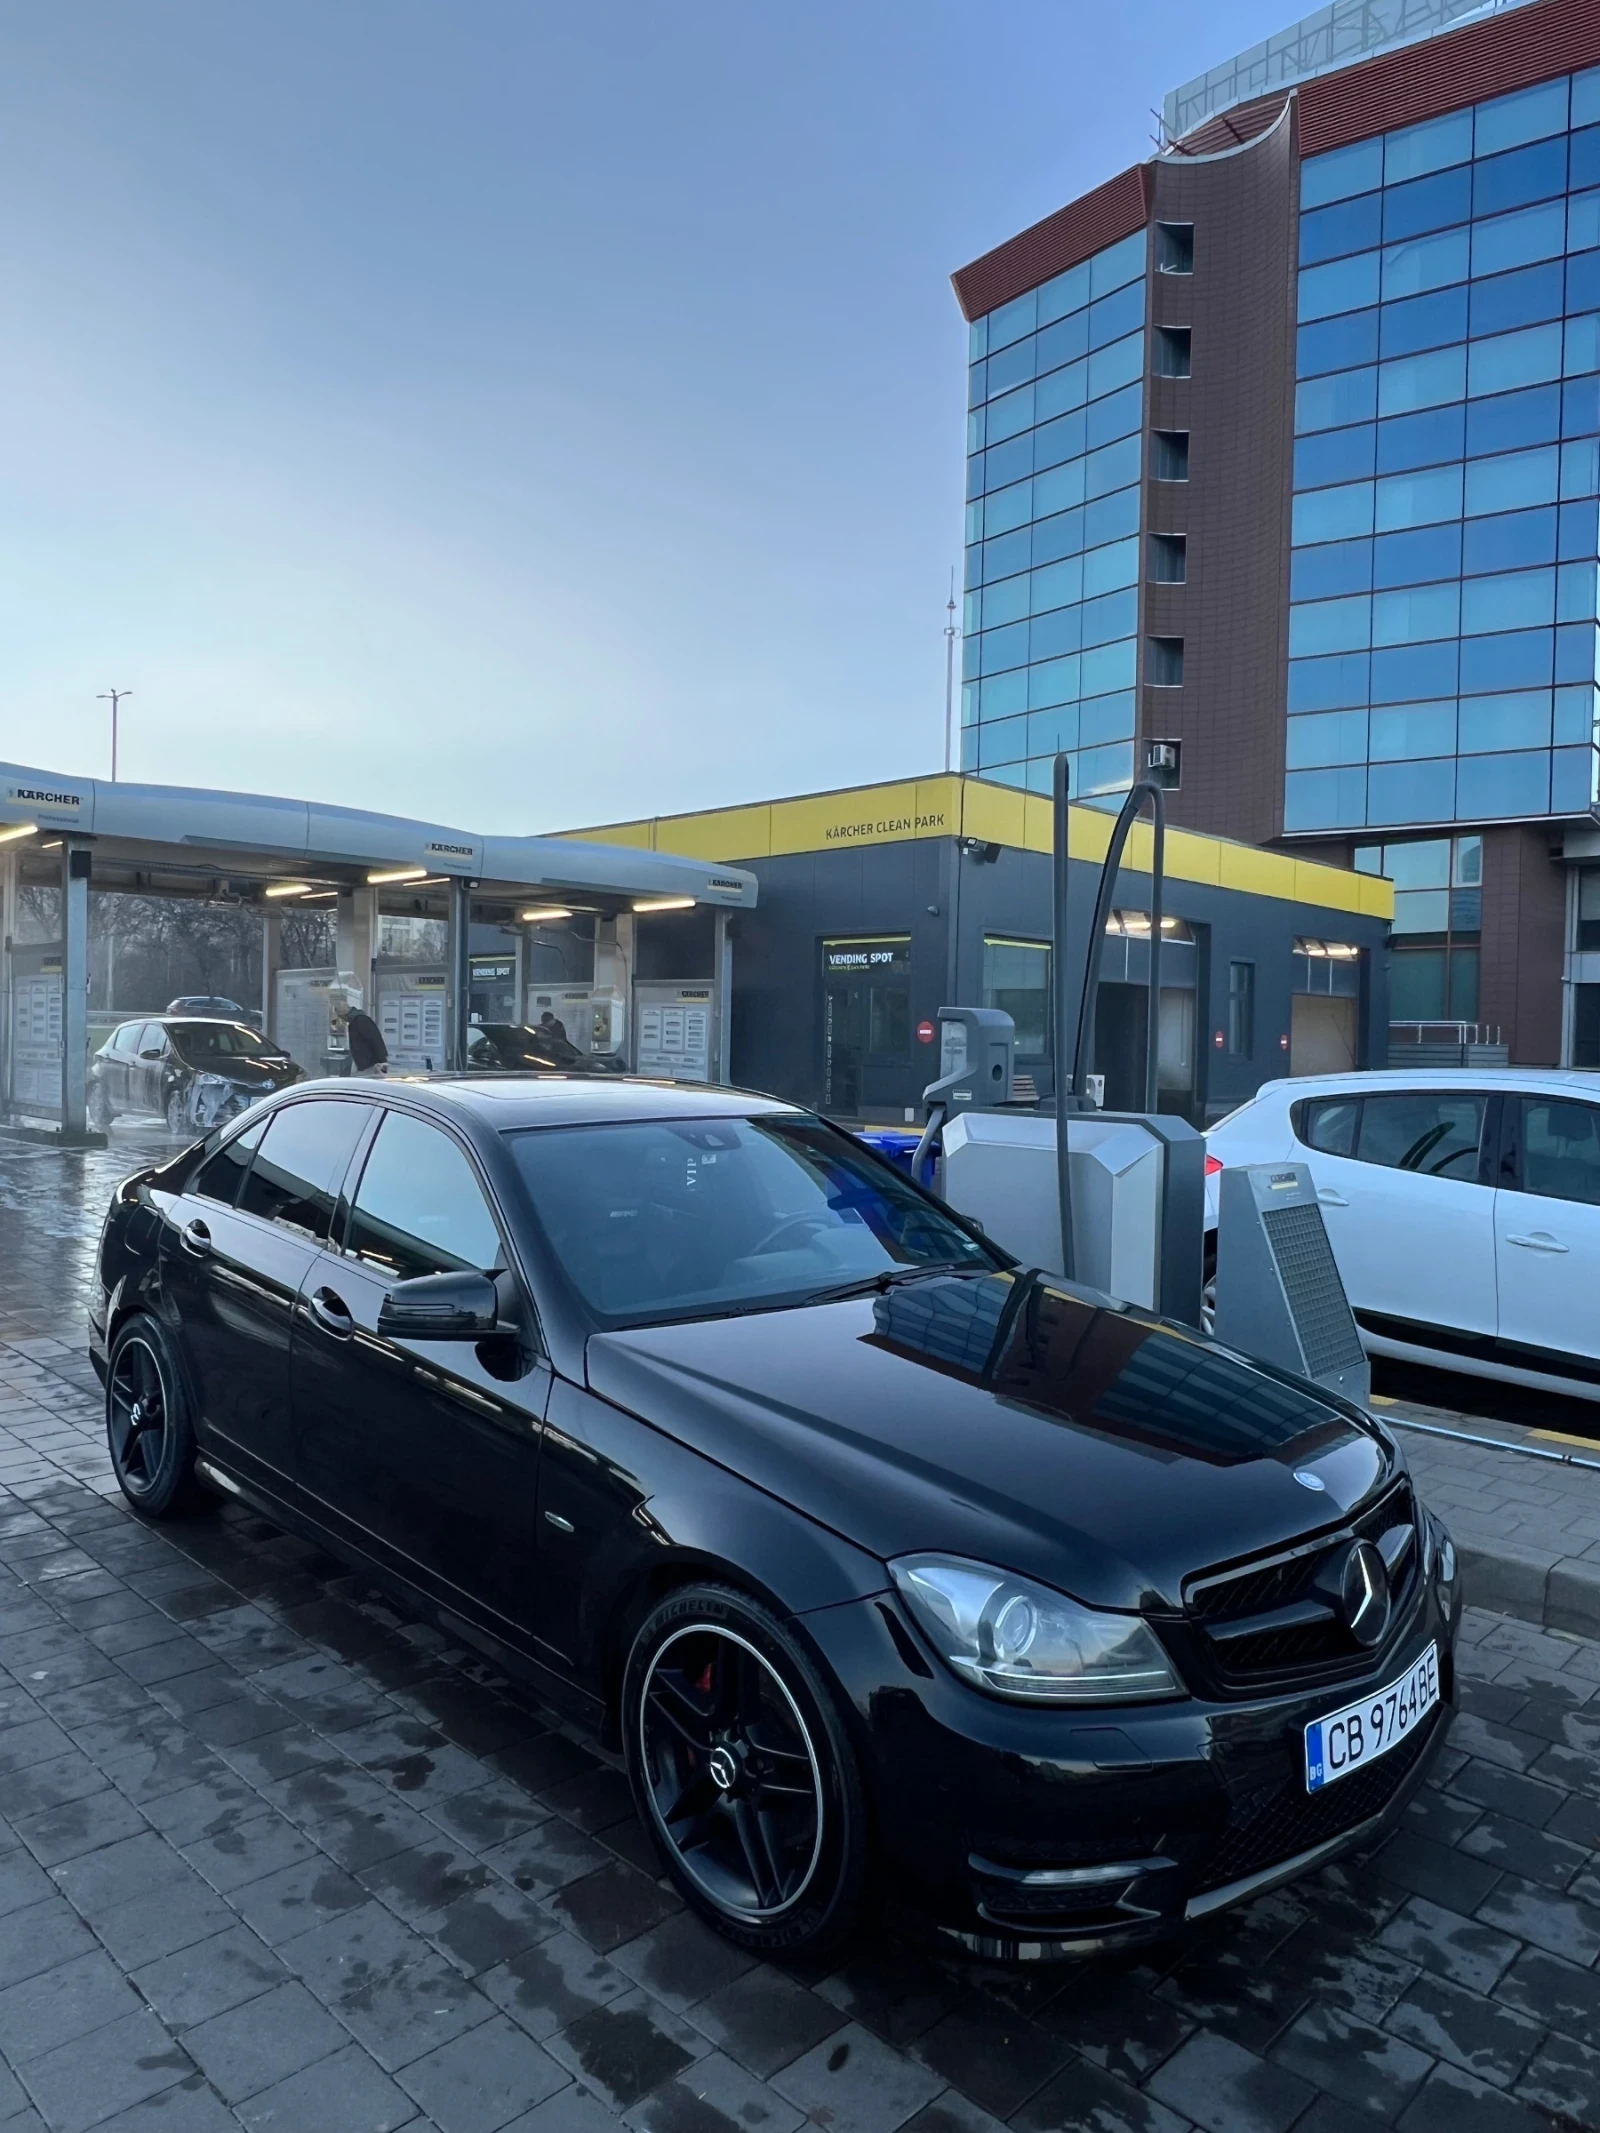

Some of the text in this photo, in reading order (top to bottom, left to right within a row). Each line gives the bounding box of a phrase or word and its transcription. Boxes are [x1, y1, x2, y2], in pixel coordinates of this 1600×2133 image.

[876, 818, 911, 834] CLEAN
[914, 814, 945, 829] PARK
[829, 952, 894, 965] VENDING SPOT
[686, 1157, 697, 1186] VIP
[1329, 1654, 1437, 1770] CB 9764 BE
[1309, 1763, 1322, 1781] BG
